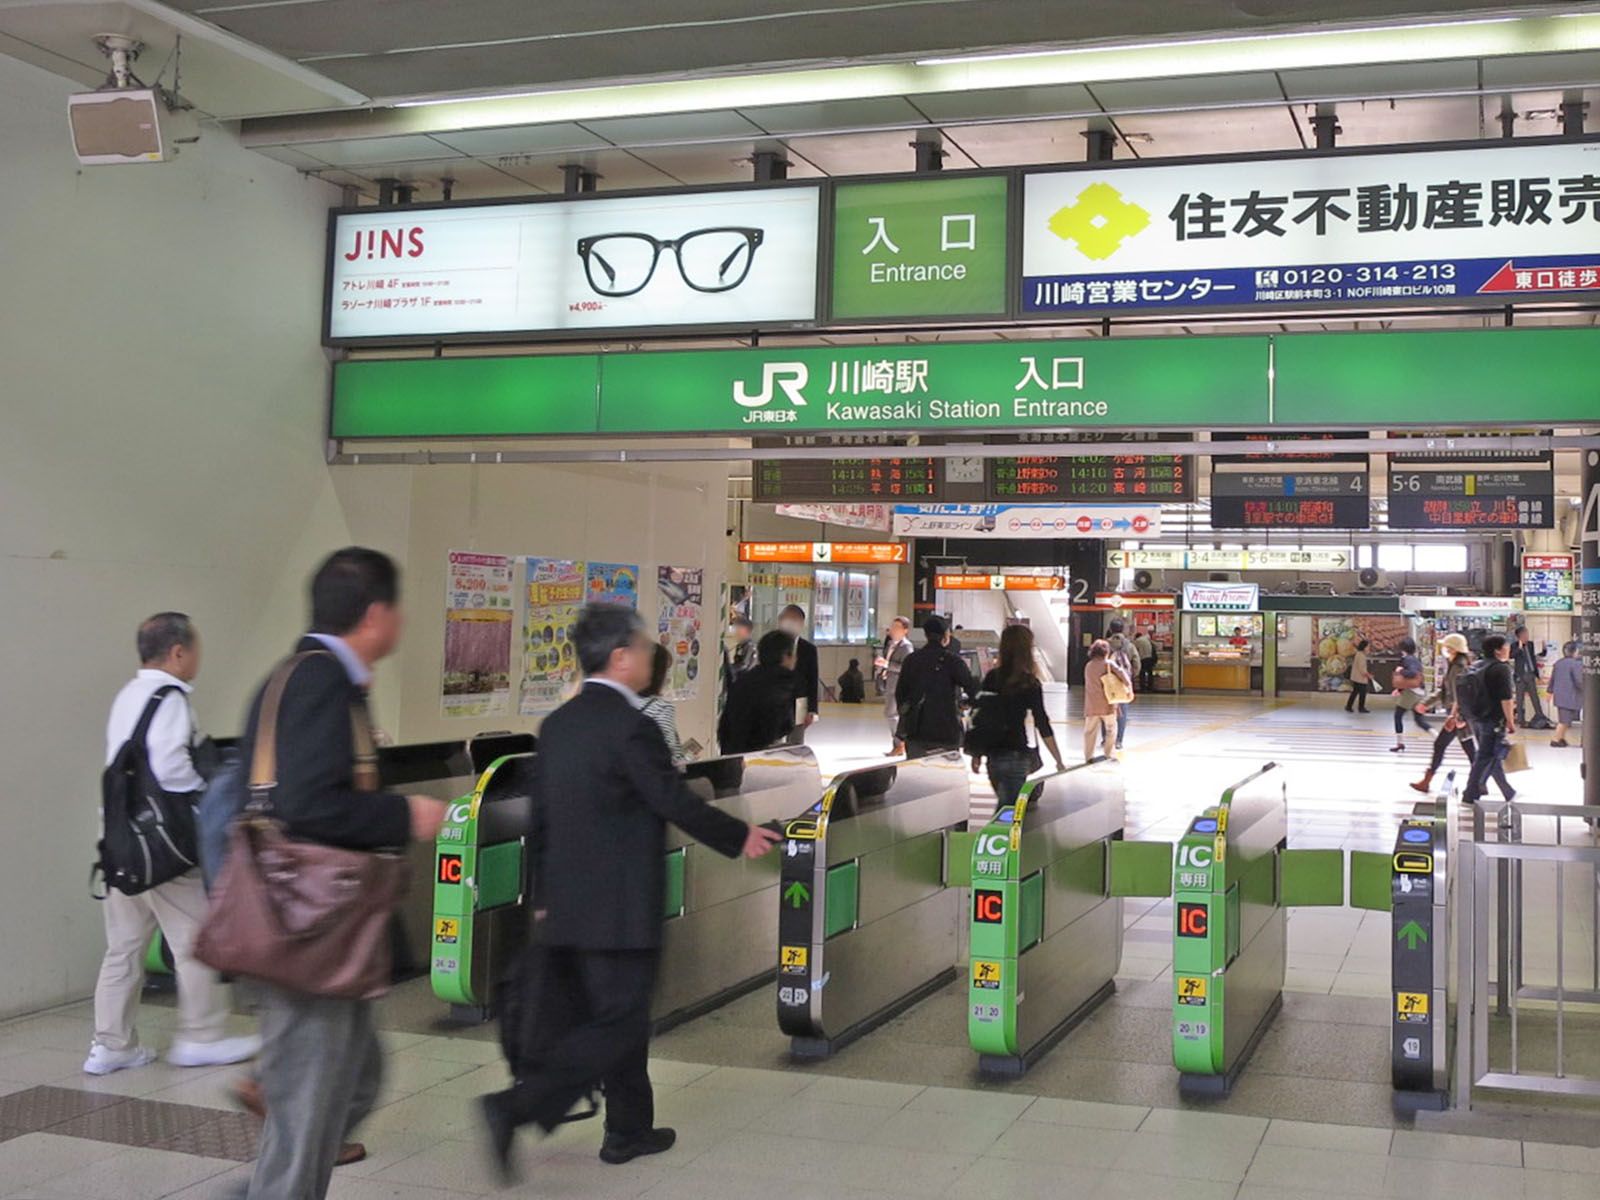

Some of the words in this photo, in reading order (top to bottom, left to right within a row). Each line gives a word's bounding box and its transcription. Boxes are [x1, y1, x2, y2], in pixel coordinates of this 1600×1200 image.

[1168, 174, 1600, 242] 住友不動産販売
[862, 213, 976, 255] 入口
[870, 261, 967, 283] Entrance
[1284, 264, 1456, 285] 0120-314-213
[1515, 269, 1598, 289] 東口徒歩
[1034, 277, 1236, 306] 川崎営業センター
[733, 361, 808, 407] JR
[827, 359, 929, 395] 川崎駅
[1015, 357, 1085, 391] 入口
[742, 409, 798, 424] JR東日本
[826, 400, 922, 420] Kawasaki
[929, 399, 1000, 419] Station
[1013, 397, 1109, 418] Entrance
[1174, 467, 1183, 479] 2
[1350, 476, 1363, 493] 4
[1174, 482, 1183, 494] 2
[743, 544, 750, 560] 1
[893, 544, 904, 561] 2
[918, 578, 928, 601] 1
[1073, 579, 1089, 603] 2
[444, 804, 470, 823] IC
[976, 833, 1009, 856] IC
[1179, 845, 1212, 868] IC
[440, 858, 462, 882] IC
[977, 894, 1002, 920] IC
[1180, 907, 1207, 934] IC
